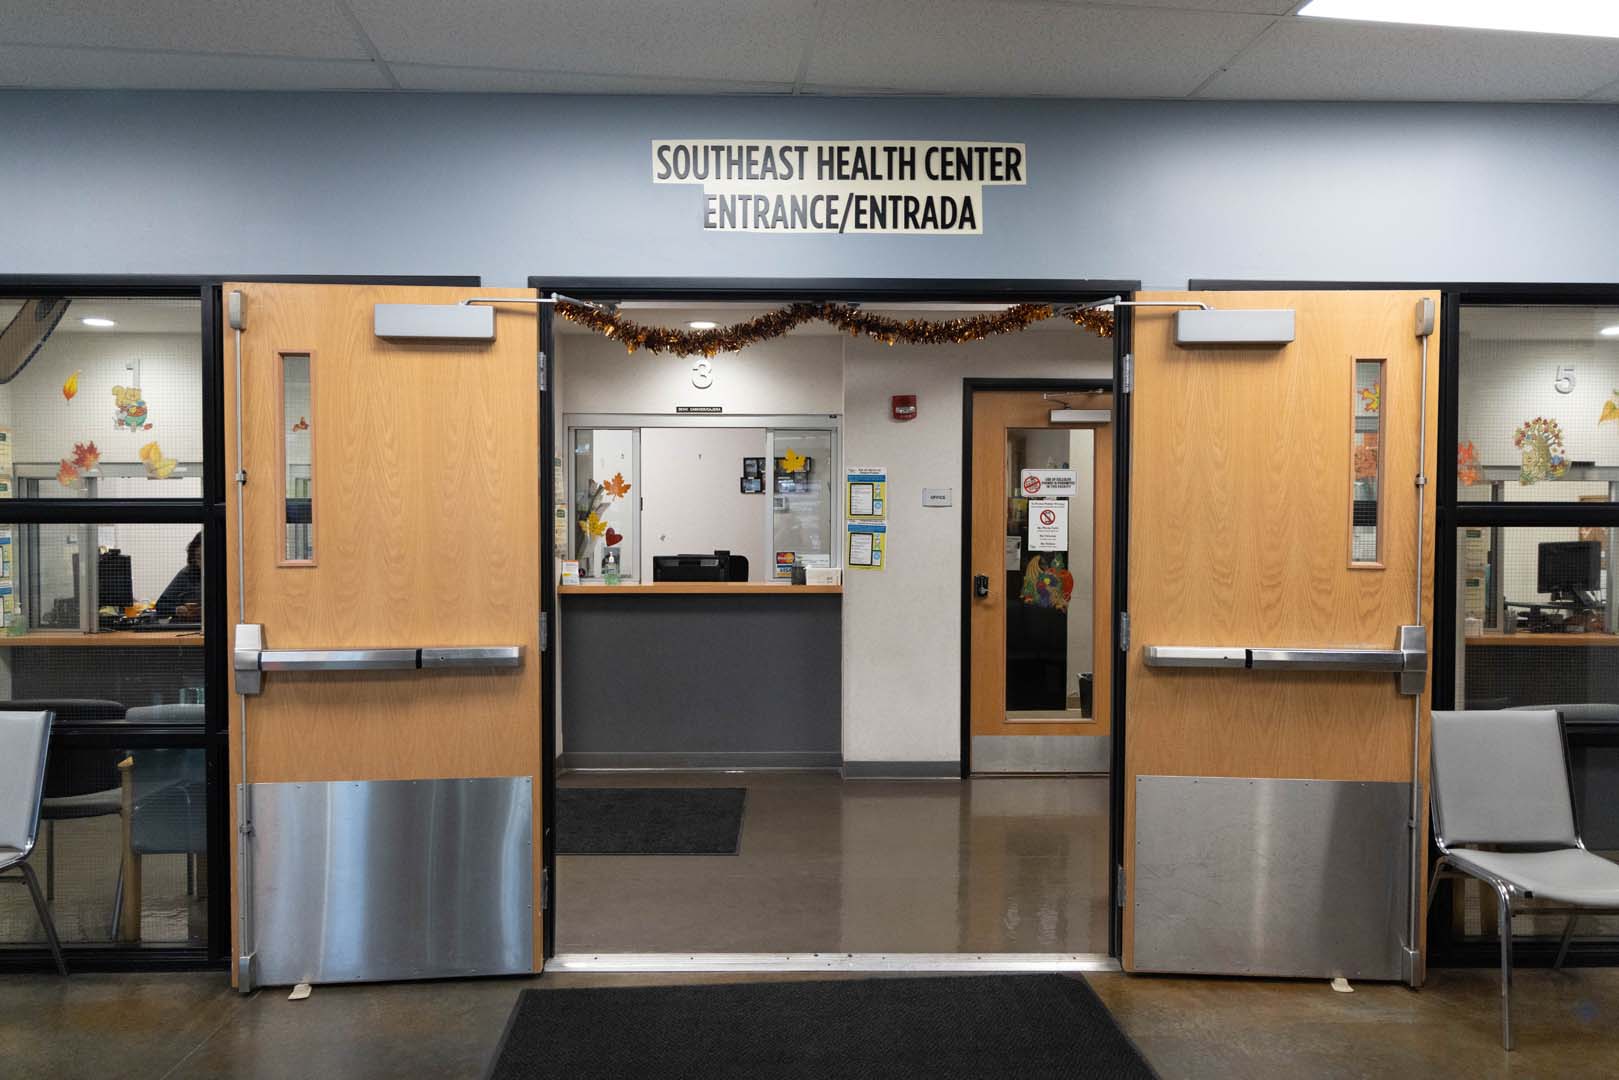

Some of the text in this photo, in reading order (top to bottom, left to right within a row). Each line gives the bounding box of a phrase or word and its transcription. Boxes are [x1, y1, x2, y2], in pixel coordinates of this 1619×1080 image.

[657, 144, 1022, 182] SOUTHEAST HEALTH CENTER
[704, 192, 977, 234] ENTRANCE/ENTRADA
[692, 359, 713, 390] 3
[1554, 365, 1576, 395] 5
